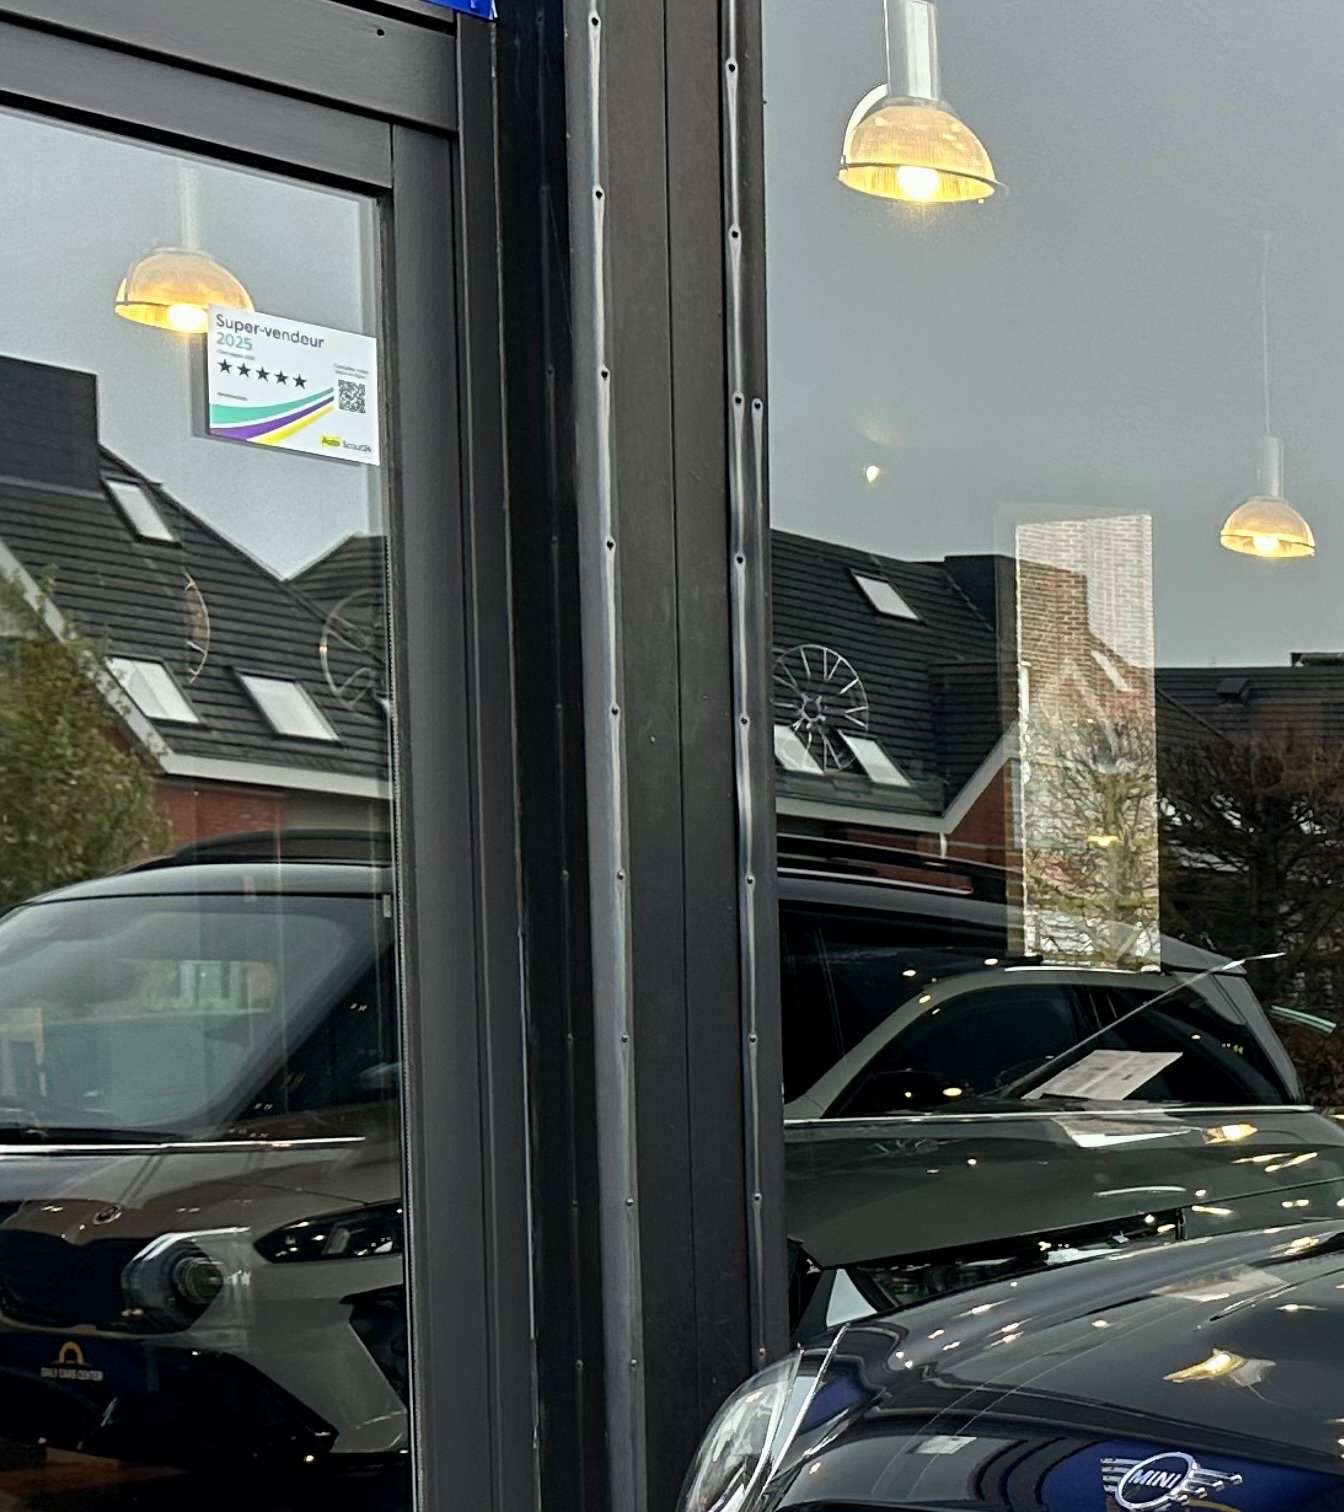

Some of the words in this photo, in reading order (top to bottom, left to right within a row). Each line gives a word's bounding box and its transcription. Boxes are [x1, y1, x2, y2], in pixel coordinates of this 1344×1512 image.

[216, 313, 325, 349] Super-vendeur
[216, 331, 253, 351] 2025
[1129, 1469, 1183, 1490] MINI
